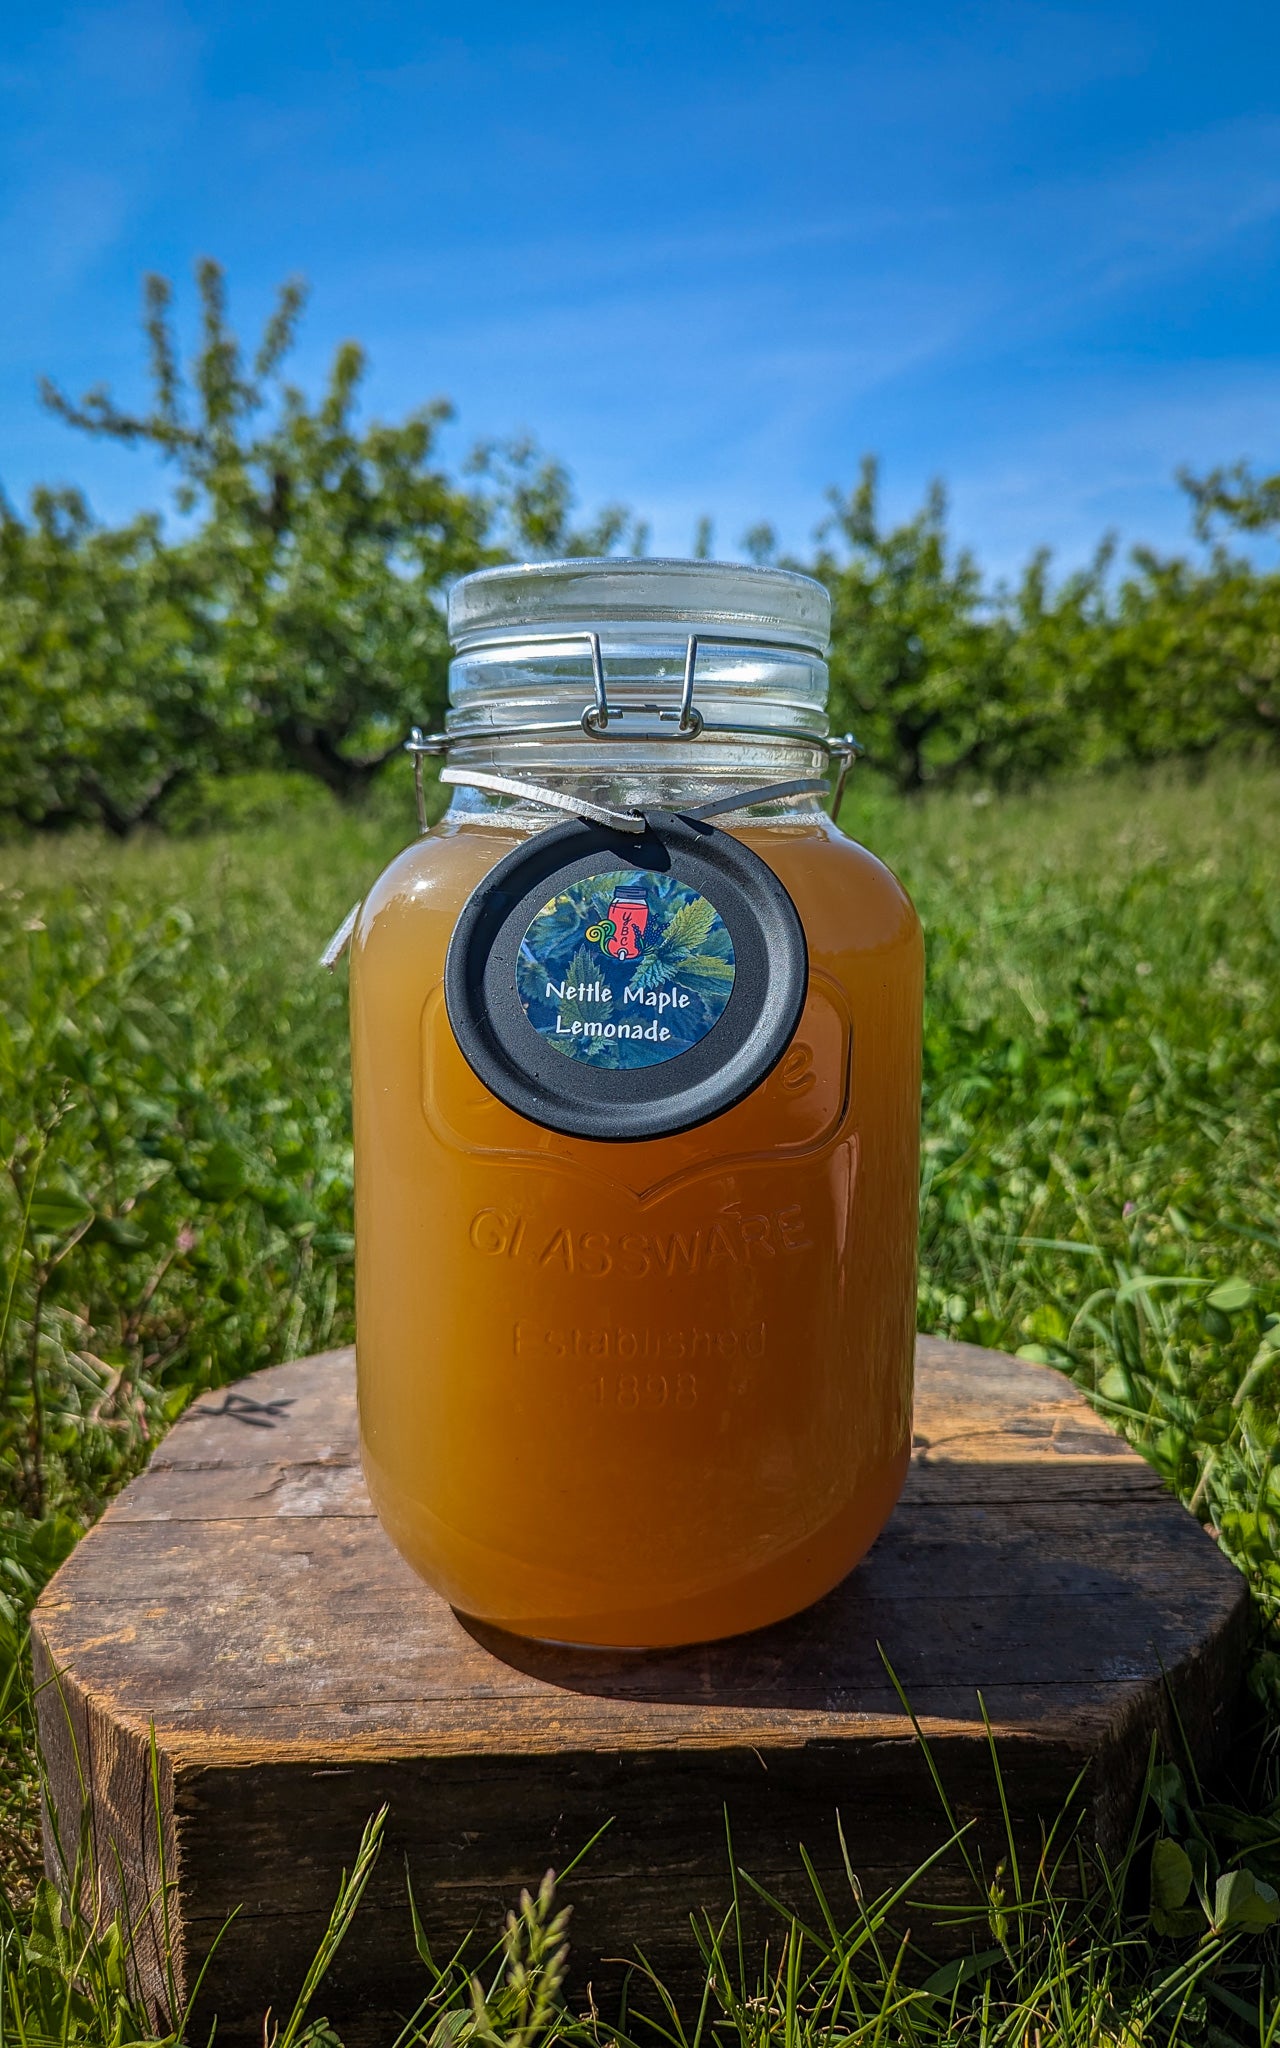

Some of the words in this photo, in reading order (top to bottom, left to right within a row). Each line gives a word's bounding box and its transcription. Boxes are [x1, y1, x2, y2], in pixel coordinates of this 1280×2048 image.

[545, 981, 613, 1003] Nettle
[623, 986, 691, 1013] Maple
[555, 1015, 671, 1041] Lemonade
[468, 1202, 815, 1280] GLASSWARE
[512, 1319, 769, 1361] Established
[592, 1372, 700, 1411] 1898
